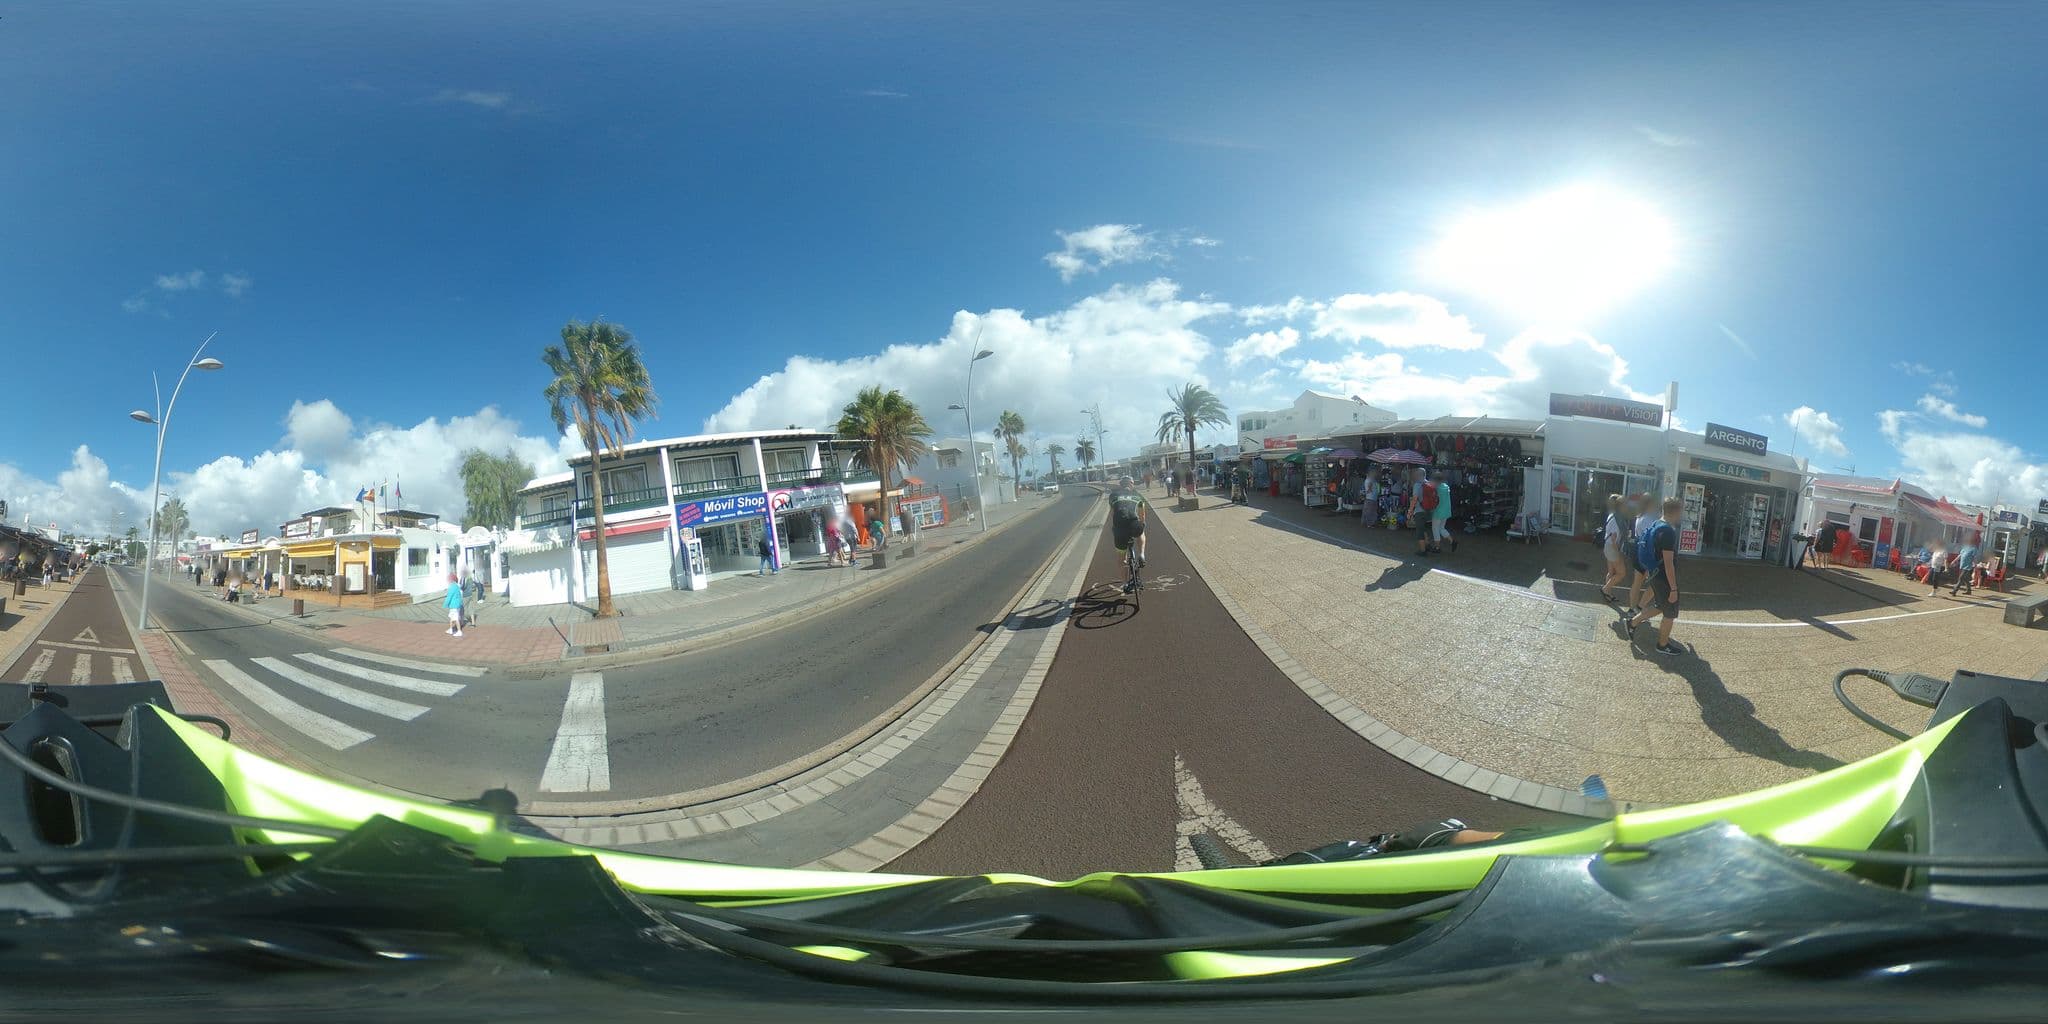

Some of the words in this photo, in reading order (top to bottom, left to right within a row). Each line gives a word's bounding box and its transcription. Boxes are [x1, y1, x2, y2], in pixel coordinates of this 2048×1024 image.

[1623, 405, 1658, 422] Vision
[1710, 430, 1765, 450] ARGENTO
[704, 498, 734, 513] Móvil
[737, 496, 765, 508] Shop
